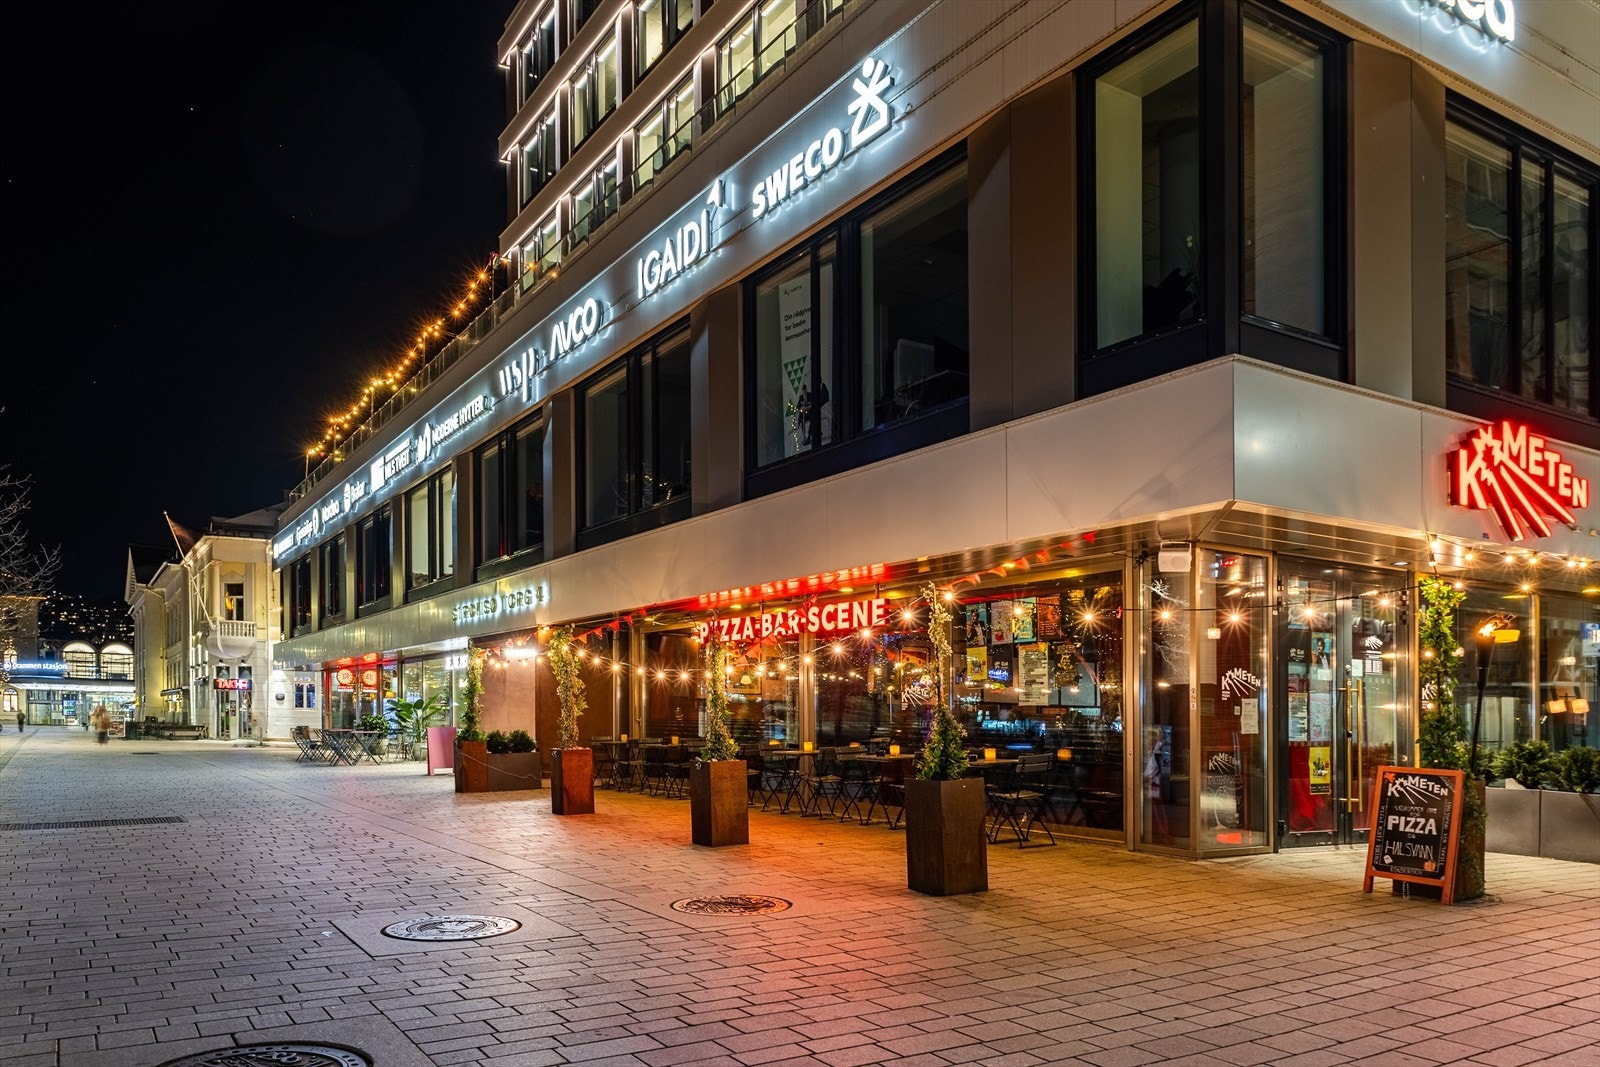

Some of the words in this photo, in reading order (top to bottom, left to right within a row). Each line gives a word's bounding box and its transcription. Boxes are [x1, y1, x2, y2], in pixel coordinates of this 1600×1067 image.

[752, 127, 844, 218] SWECO
[432, 412, 460, 446] MODERNE
[459, 394, 485, 426] HYTTER
[12, 662, 42, 670] Drammen
[42, 663, 68, 671] stasjon
[1387, 815, 1437, 835] PIZZA
